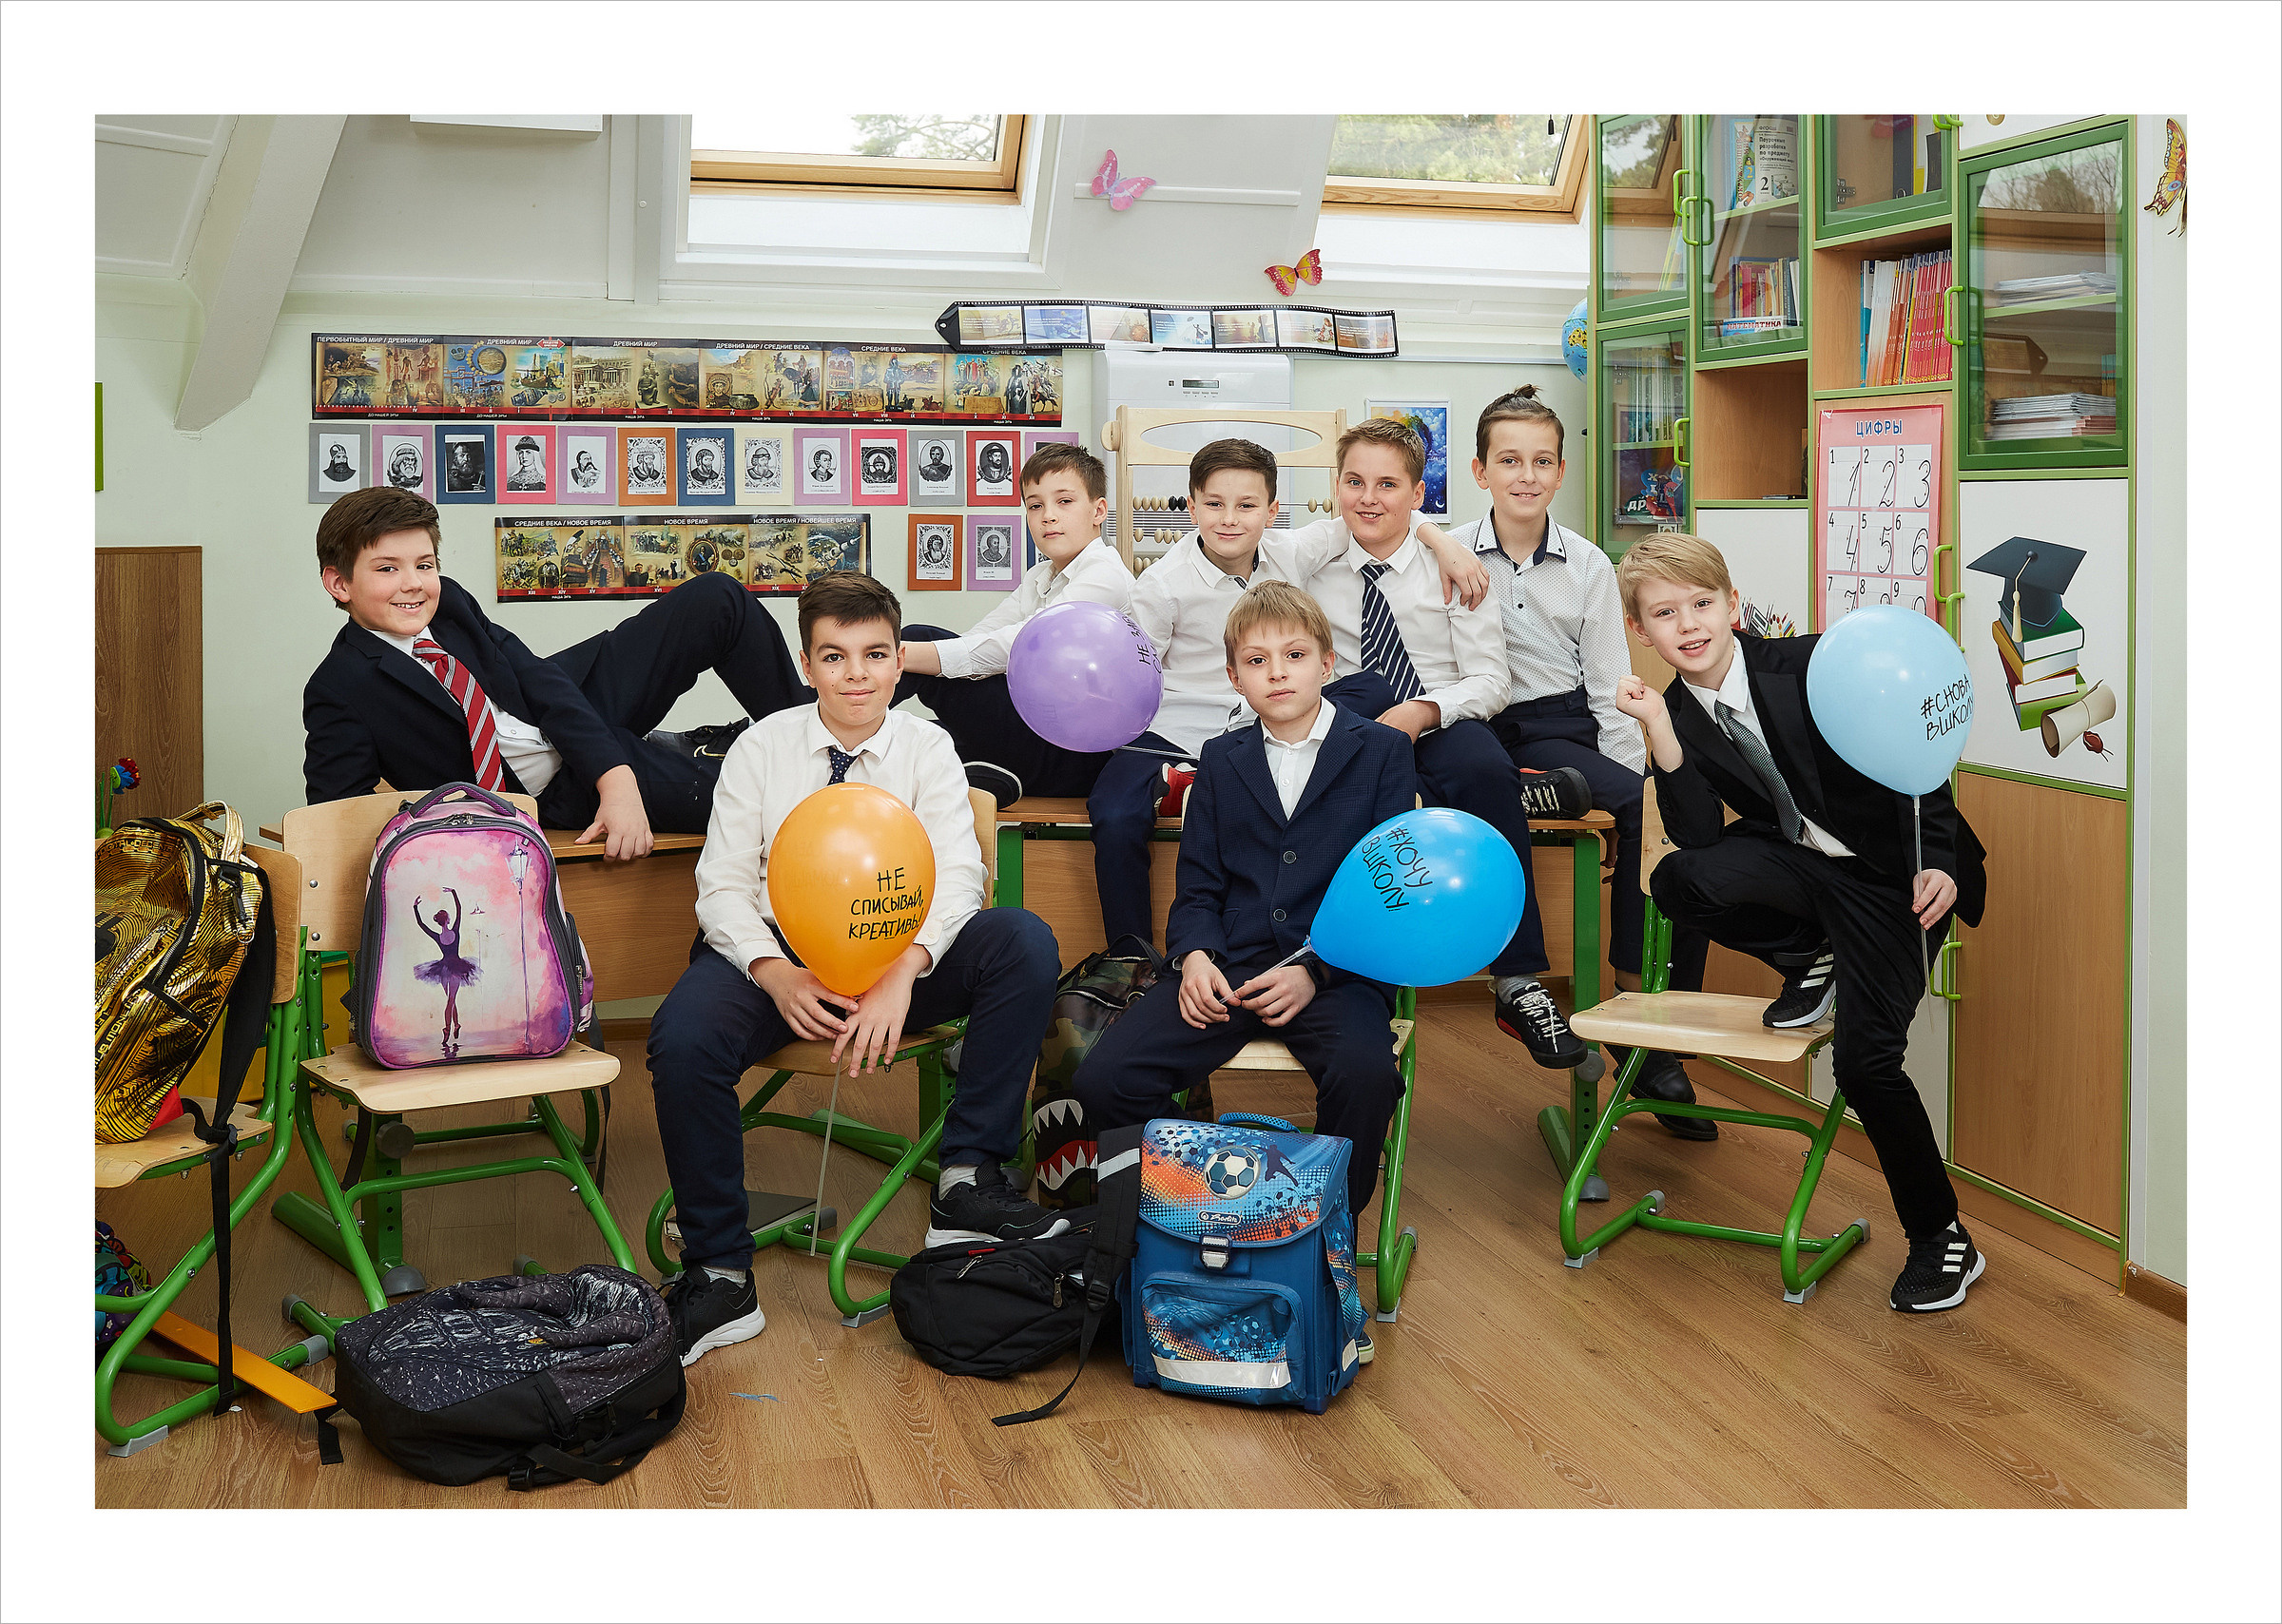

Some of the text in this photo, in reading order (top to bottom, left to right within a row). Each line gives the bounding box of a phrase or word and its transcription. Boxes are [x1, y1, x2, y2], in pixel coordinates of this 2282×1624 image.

[1747, 166, 1753, 179] 2
[1760, 176, 1769, 191] 2
[1726, 320, 1782, 330] МАТЕМАТИКА
[1855, 418, 1903, 438] ЦИФРЫ
[1829, 449, 1835, 464] 1
[1864, 449, 1869, 464] 2
[1898, 448, 1905, 464] 3
[1849, 460, 1861, 507] 1
[1879, 460, 1895, 508] 2
[1914, 459, 1931, 508] 3
[1828, 512, 1835, 528] 4
[1861, 513, 1867, 529] 5
[1895, 514, 1902, 531] 6
[1846, 525, 1859, 571] 4
[1877, 526, 1893, 573] 5
[1911, 528, 1929, 576] 6
[1828, 576, 1833, 591] 7
[1859, 578, 1866, 595] 8
[1893, 581, 1900, 598] 9
[1920, 673, 1971, 719] #СНОВА
[1385, 827, 1433, 888] #ХОЧУ
[877, 866, 906, 893] НЕ
[1362, 835, 1410, 910] ВШКОЛУ
[850, 884, 924, 916] СПИСЫВАЙ,
[848, 907, 924, 940] КРЕАТИВЬ!
